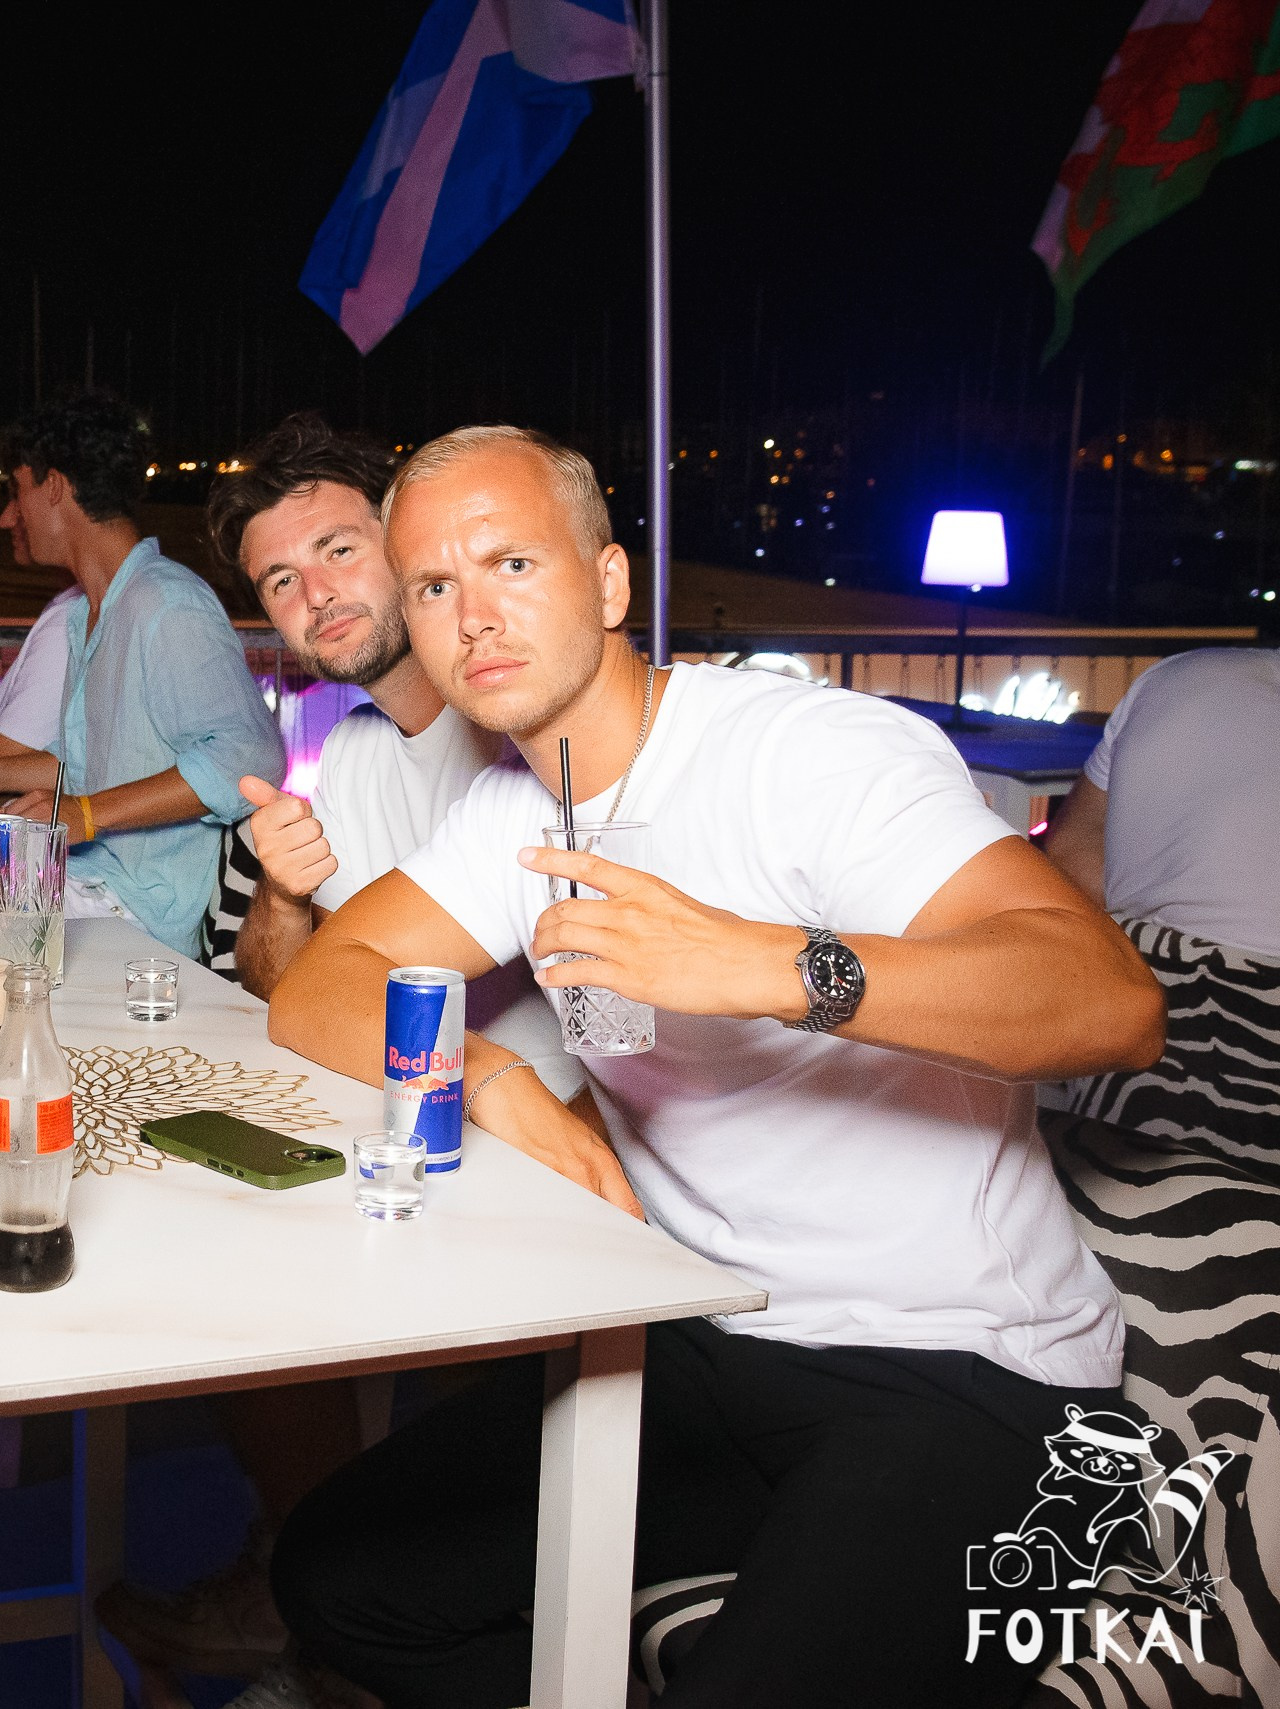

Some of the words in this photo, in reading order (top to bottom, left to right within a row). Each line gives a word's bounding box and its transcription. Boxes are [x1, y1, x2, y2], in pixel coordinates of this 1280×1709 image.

[389, 1046, 426, 1073] Red
[429, 1047, 462, 1072] Bull
[390, 1091, 427, 1103] ENERGY
[432, 1092, 459, 1104] DRINK
